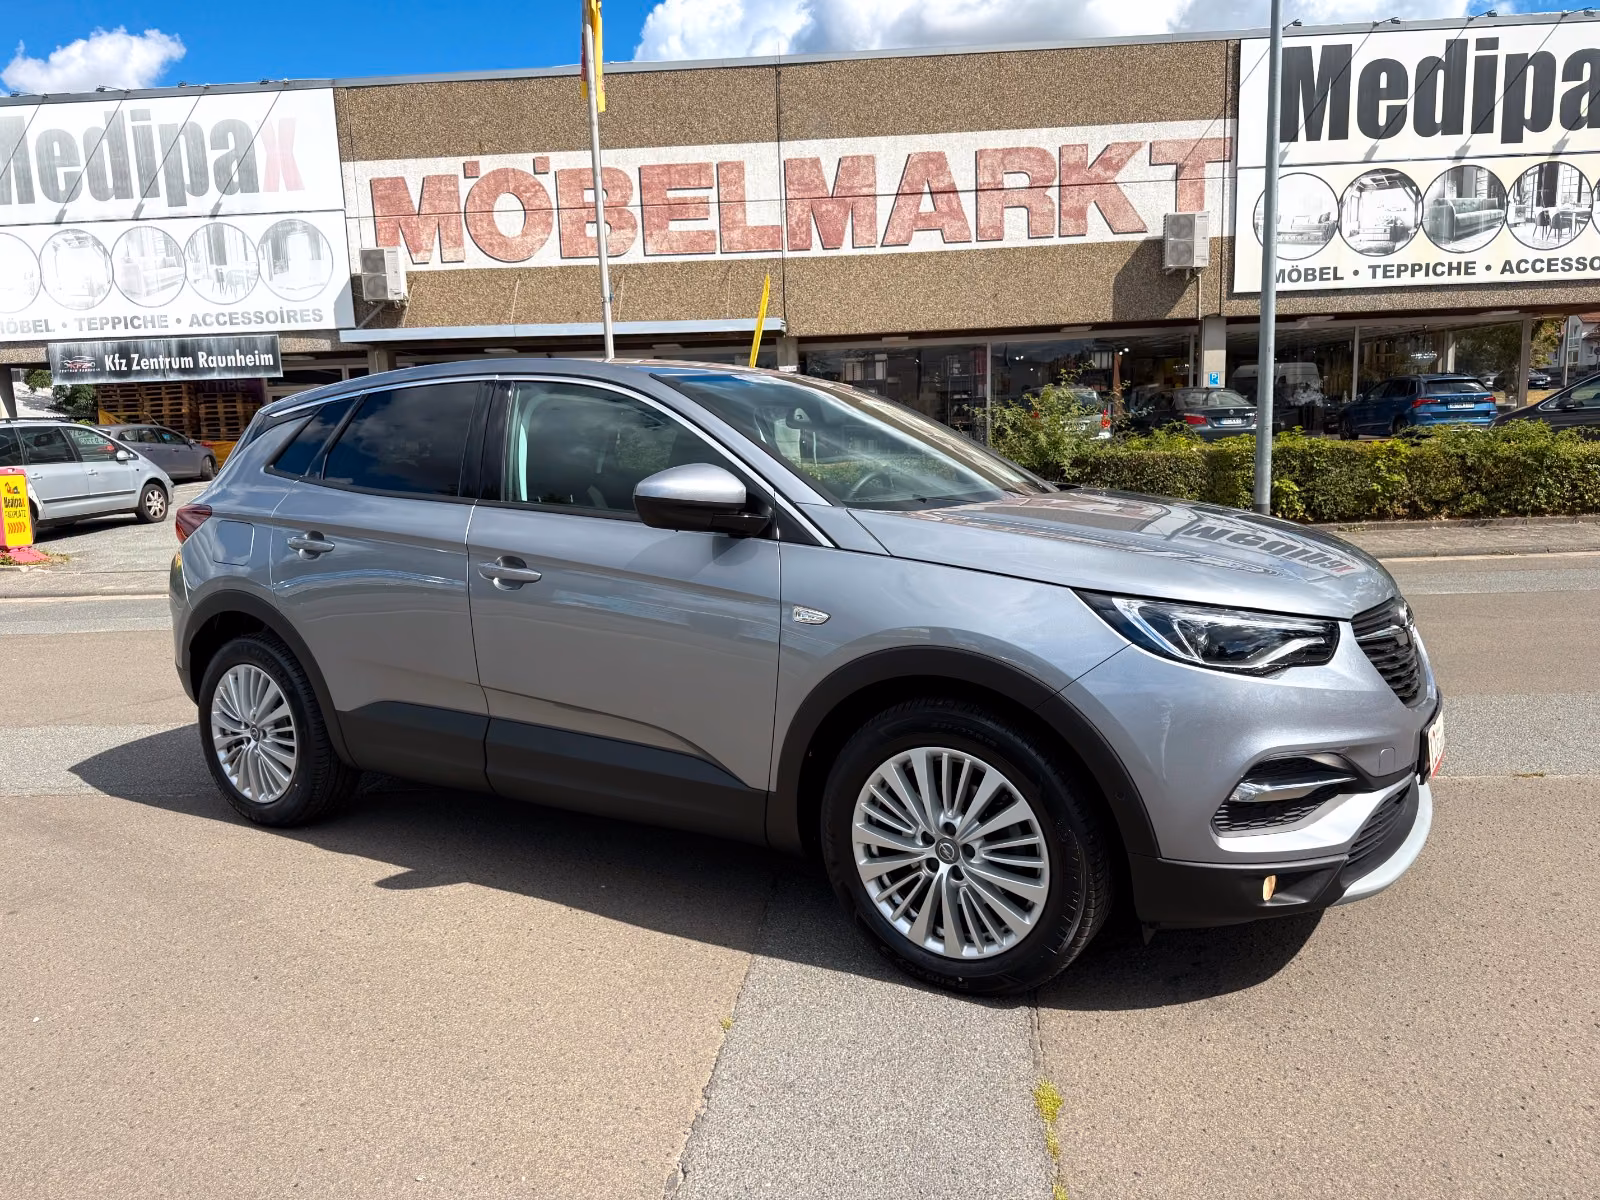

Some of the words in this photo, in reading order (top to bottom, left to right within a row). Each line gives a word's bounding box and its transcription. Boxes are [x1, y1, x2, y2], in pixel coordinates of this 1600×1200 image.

[370, 137, 1232, 264] MÖBELMARKT
[1368, 261, 1477, 280] TEPPICHE
[73, 314, 169, 331] TEPPICHE
[104, 353, 127, 372] Kfz
[131, 353, 194, 371] Zentrum
[198, 349, 274, 368] Raunheim
